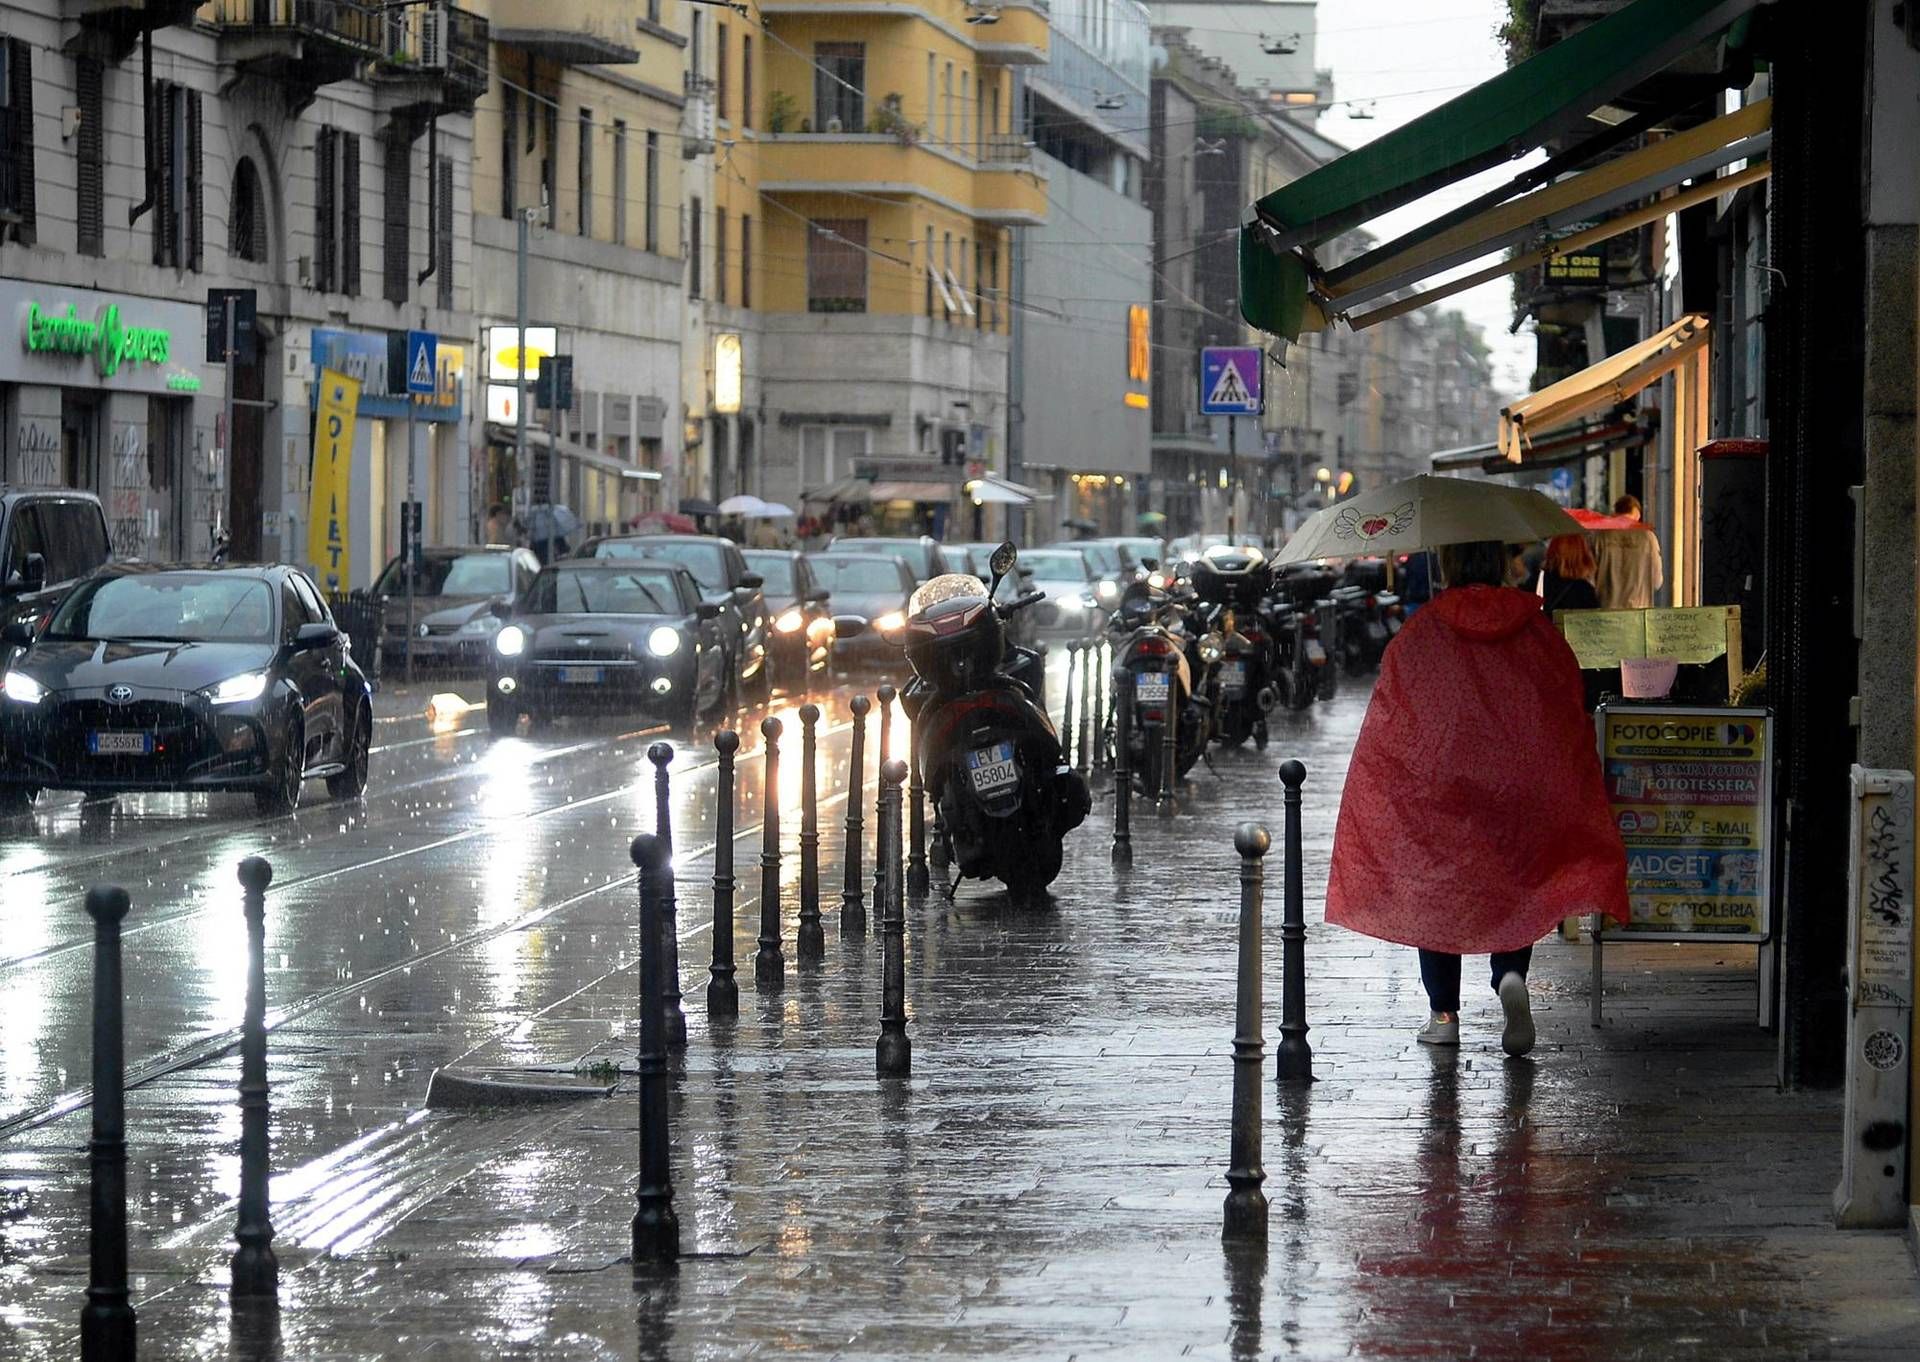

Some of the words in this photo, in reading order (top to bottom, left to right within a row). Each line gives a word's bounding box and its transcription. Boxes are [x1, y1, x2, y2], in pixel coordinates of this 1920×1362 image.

[1571, 256, 1600, 266] ORE
[1613, 725, 1715, 741] FOTOCOPIE
[974, 763, 1015, 787] 95804
[1655, 764, 1706, 775] STAMPA
[1708, 765, 1744, 776] FOTO
[1647, 778, 1756, 792] FOTOTESSERA
[1664, 810, 1695, 820] INVIO
[1664, 821, 1692, 834] FAX
[1702, 822, 1752, 834] E-MAIL
[1627, 855, 1710, 875] ADGET
